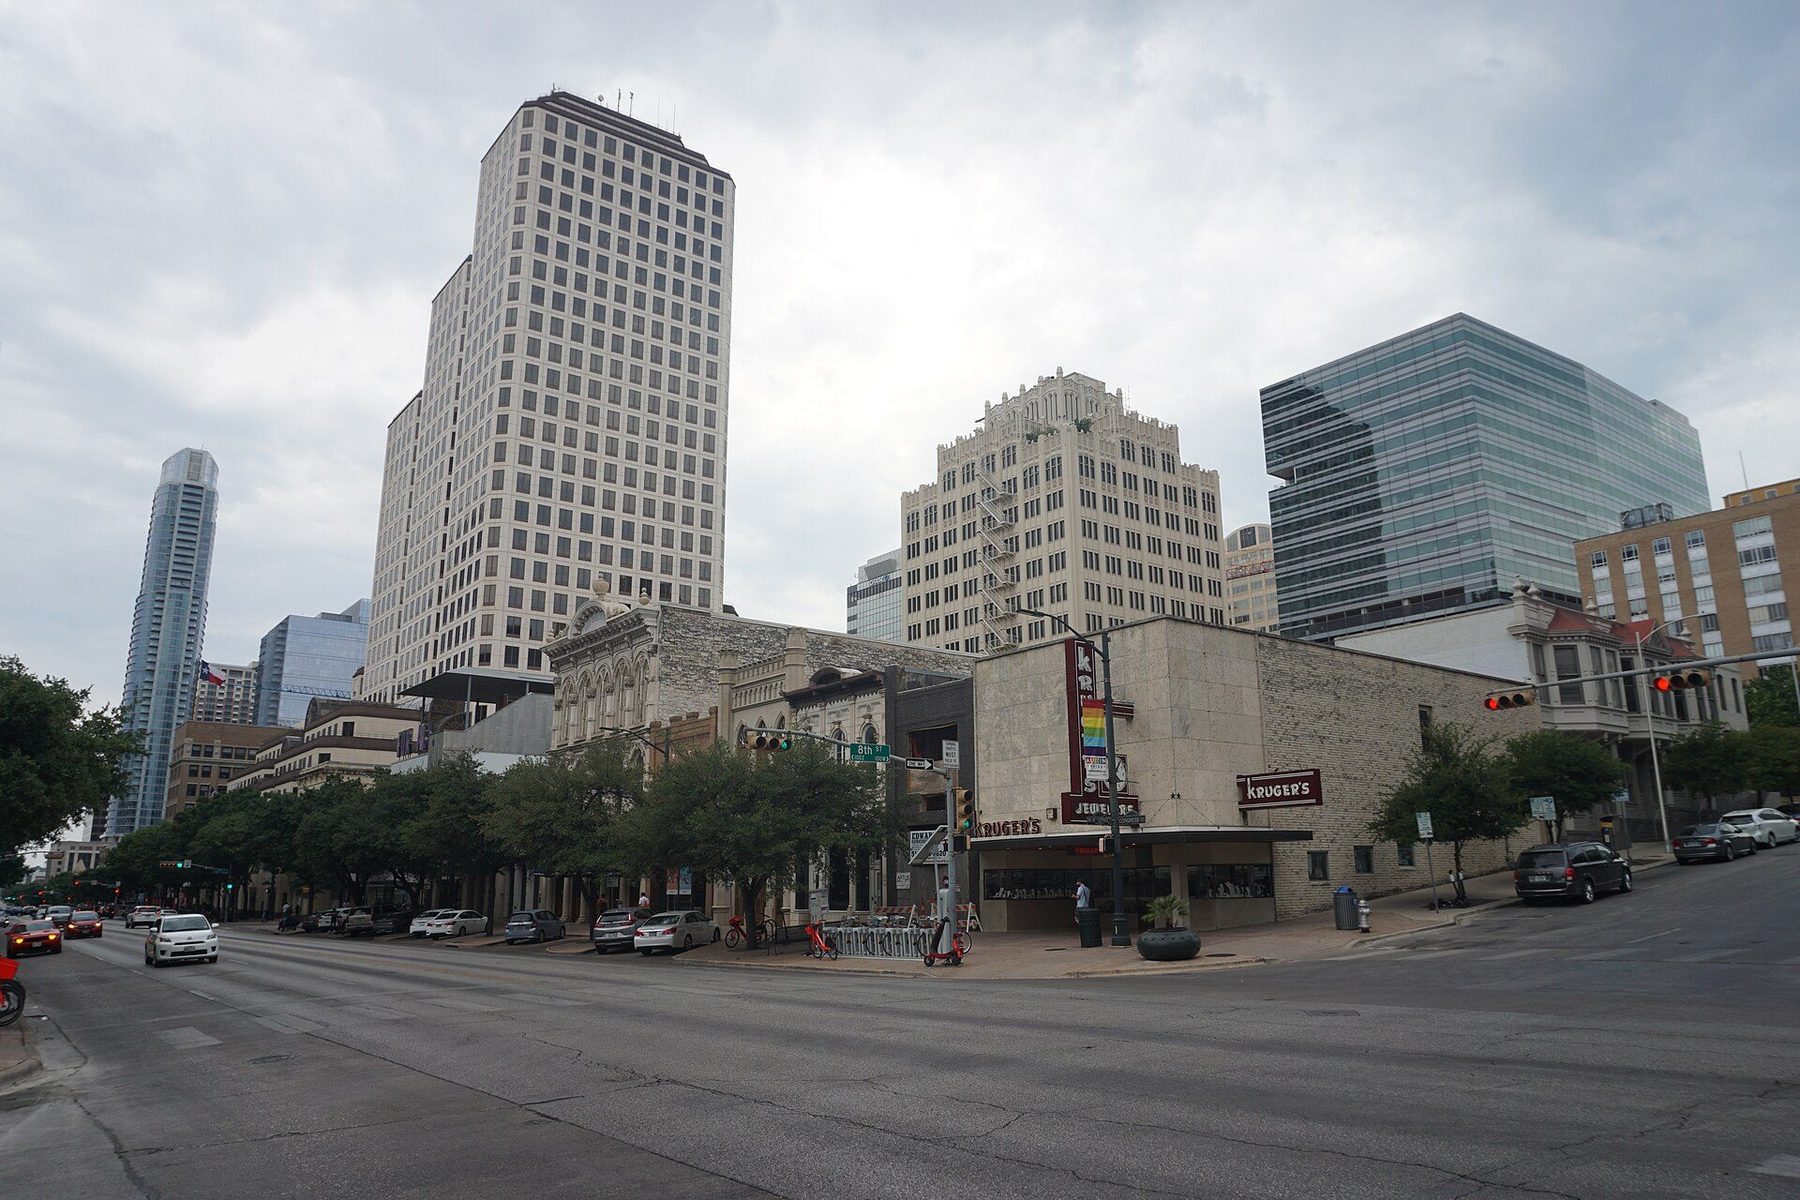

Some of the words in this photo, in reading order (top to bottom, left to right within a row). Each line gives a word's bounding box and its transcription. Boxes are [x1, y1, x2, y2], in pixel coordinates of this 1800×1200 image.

[857, 744, 873, 755] 8th
[1247, 777, 1310, 799] KRUGER'S
[1075, 802, 1134, 816] JEWELR
[911, 832, 935, 840] EDWAR
